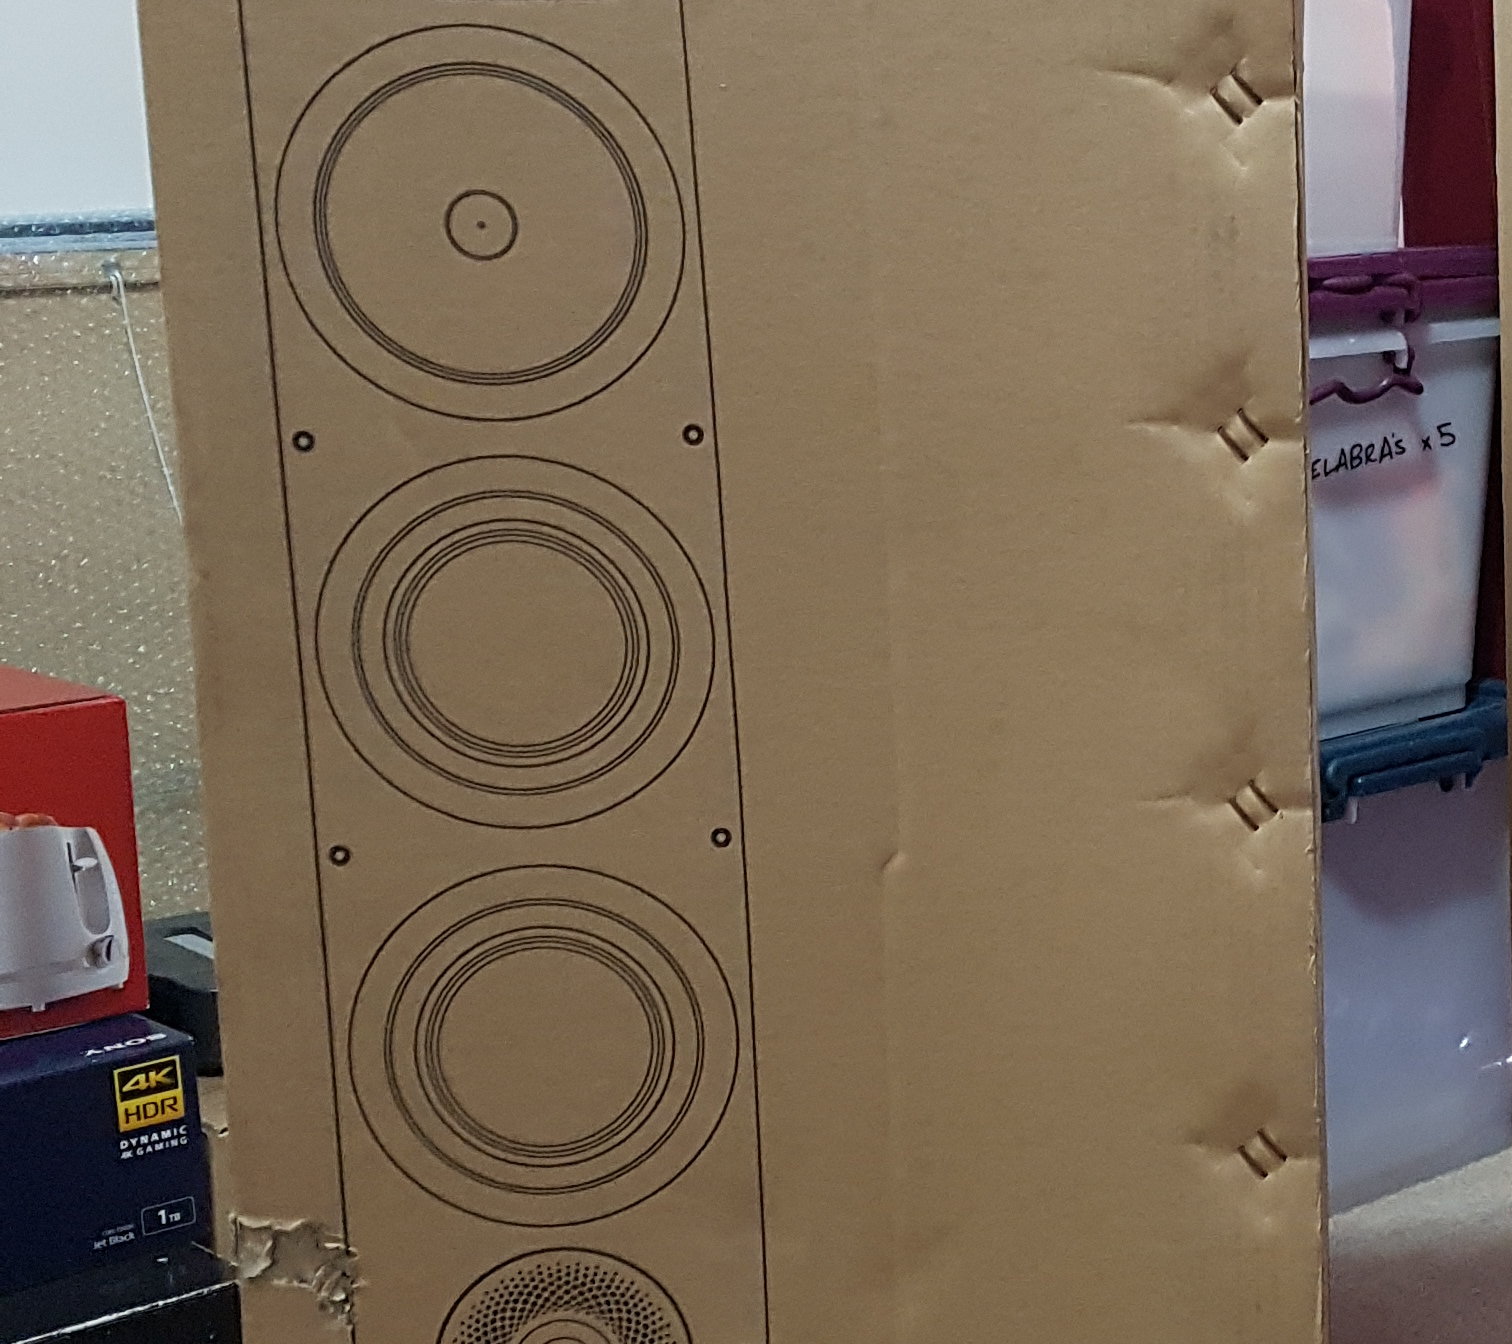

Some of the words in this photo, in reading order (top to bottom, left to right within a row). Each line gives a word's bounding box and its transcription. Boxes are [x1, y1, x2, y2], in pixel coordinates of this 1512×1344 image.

[1437, 422, 1456, 448] 5
[121, 1065, 176, 1093] 4K
[124, 1096, 179, 1125] HDR
[119, 1124, 189, 1150] DYNAMIC
[137, 1136, 189, 1156] GAMING
